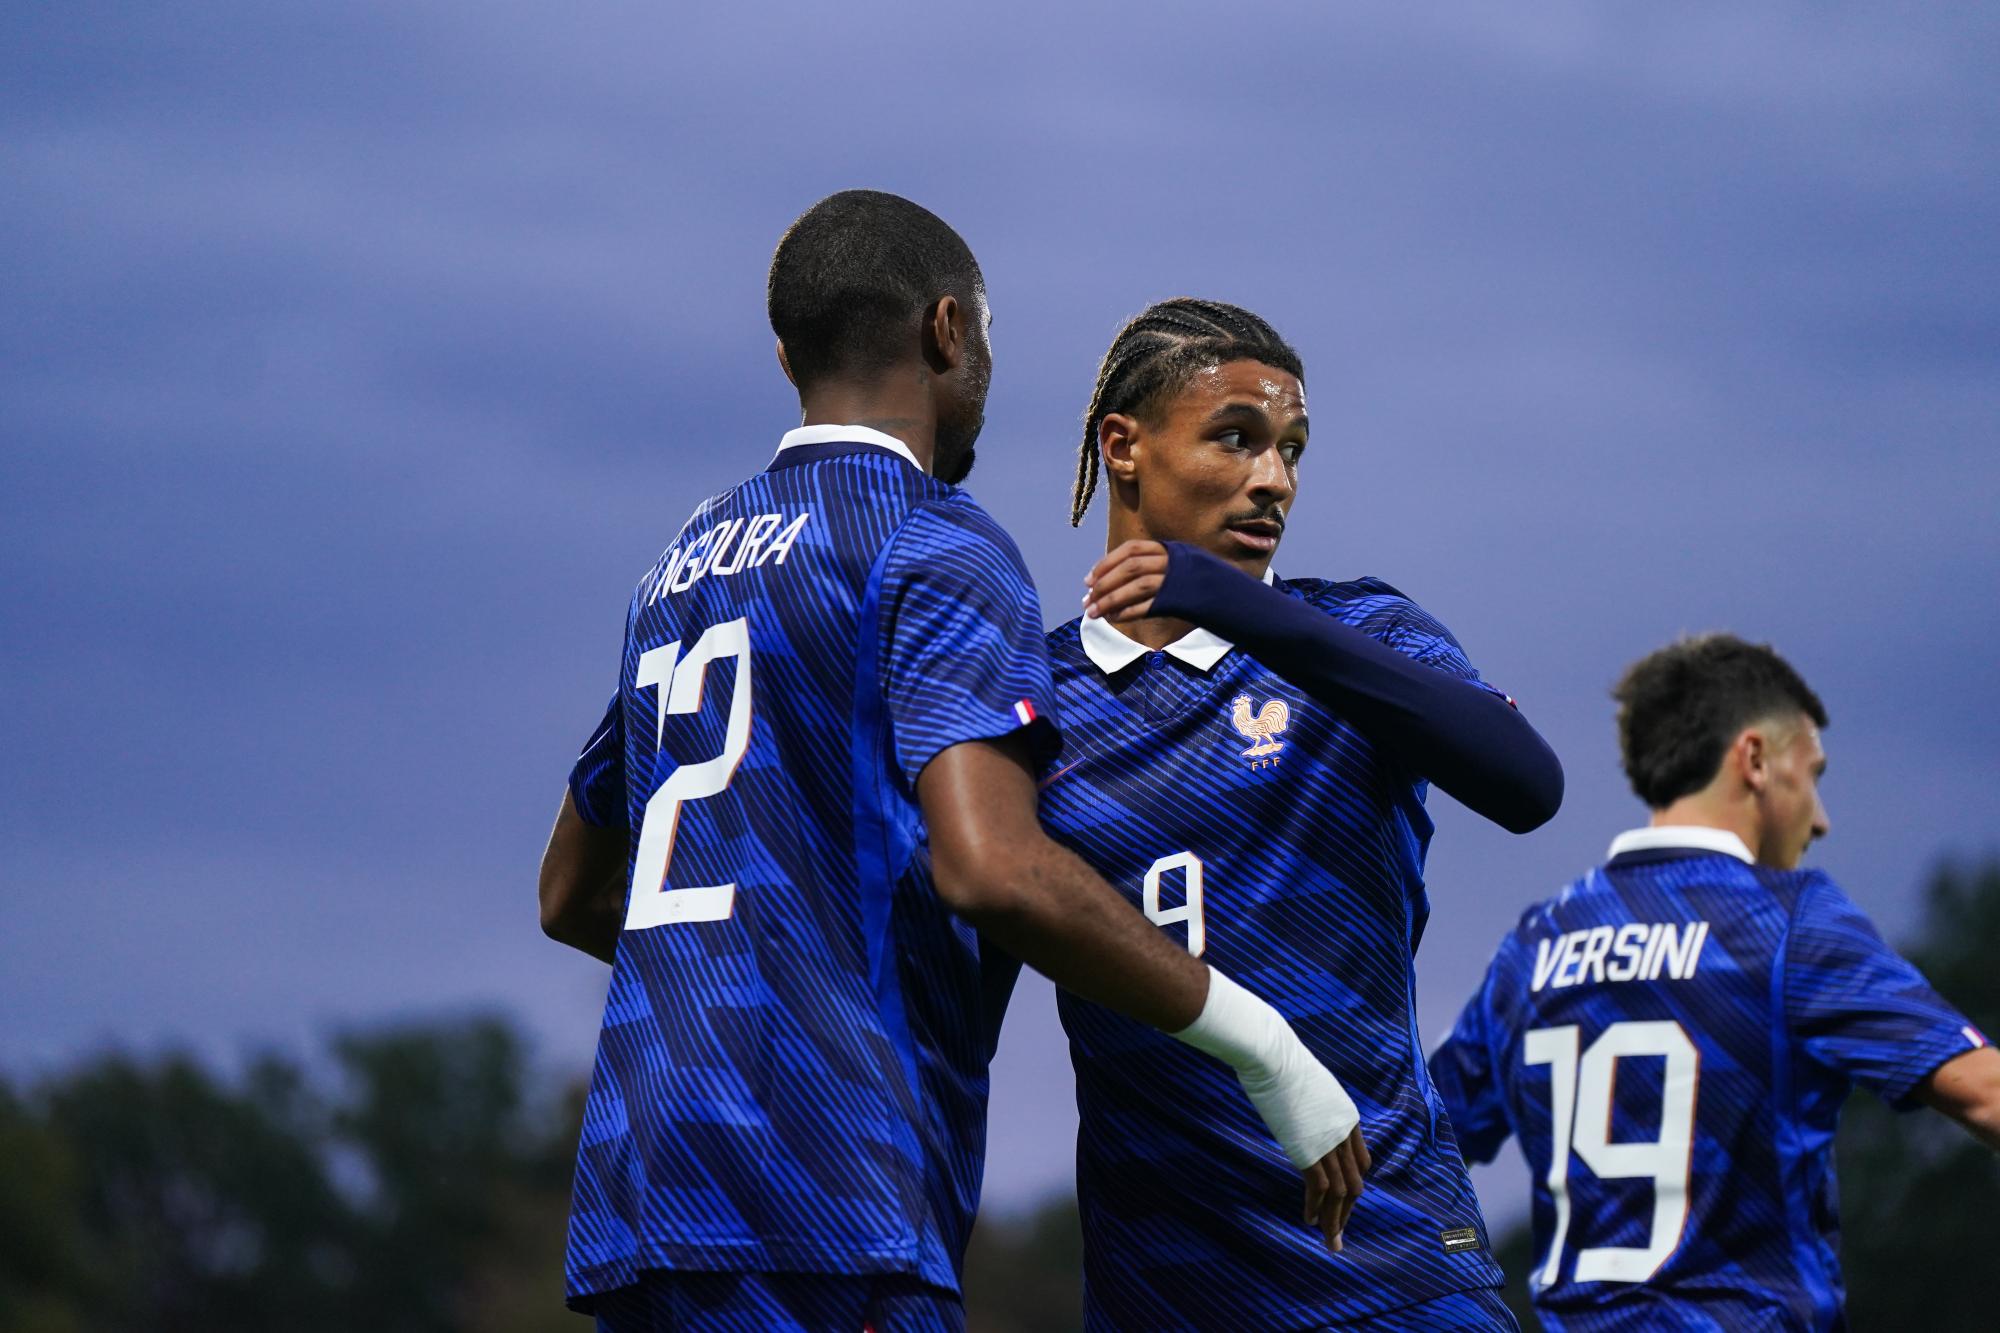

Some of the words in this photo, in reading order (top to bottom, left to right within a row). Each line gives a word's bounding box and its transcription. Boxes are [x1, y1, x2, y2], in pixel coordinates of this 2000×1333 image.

[648, 513, 809, 607] NGOURA
[1143, 851, 1205, 958] 9
[1532, 922, 1708, 992] VERSINI
[1524, 1020, 1700, 1285] 19
